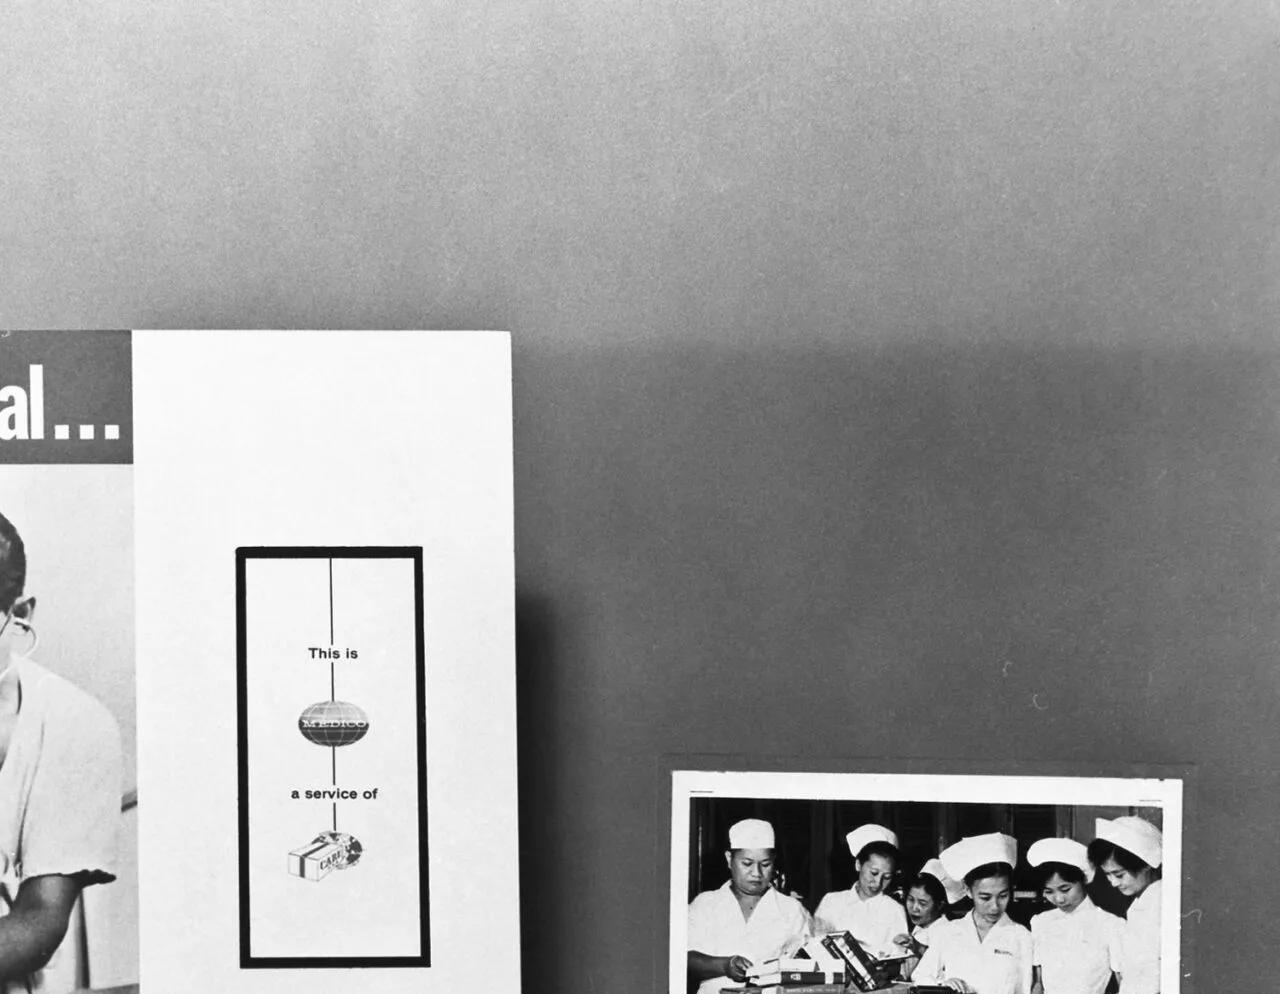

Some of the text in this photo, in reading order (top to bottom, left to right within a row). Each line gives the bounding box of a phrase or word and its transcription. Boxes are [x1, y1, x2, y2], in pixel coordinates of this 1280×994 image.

[308, 647, 358, 659] This is
[302, 718, 367, 728] MEDICO
[291, 788, 378, 800] a service of
[320, 849, 344, 871] CARE
